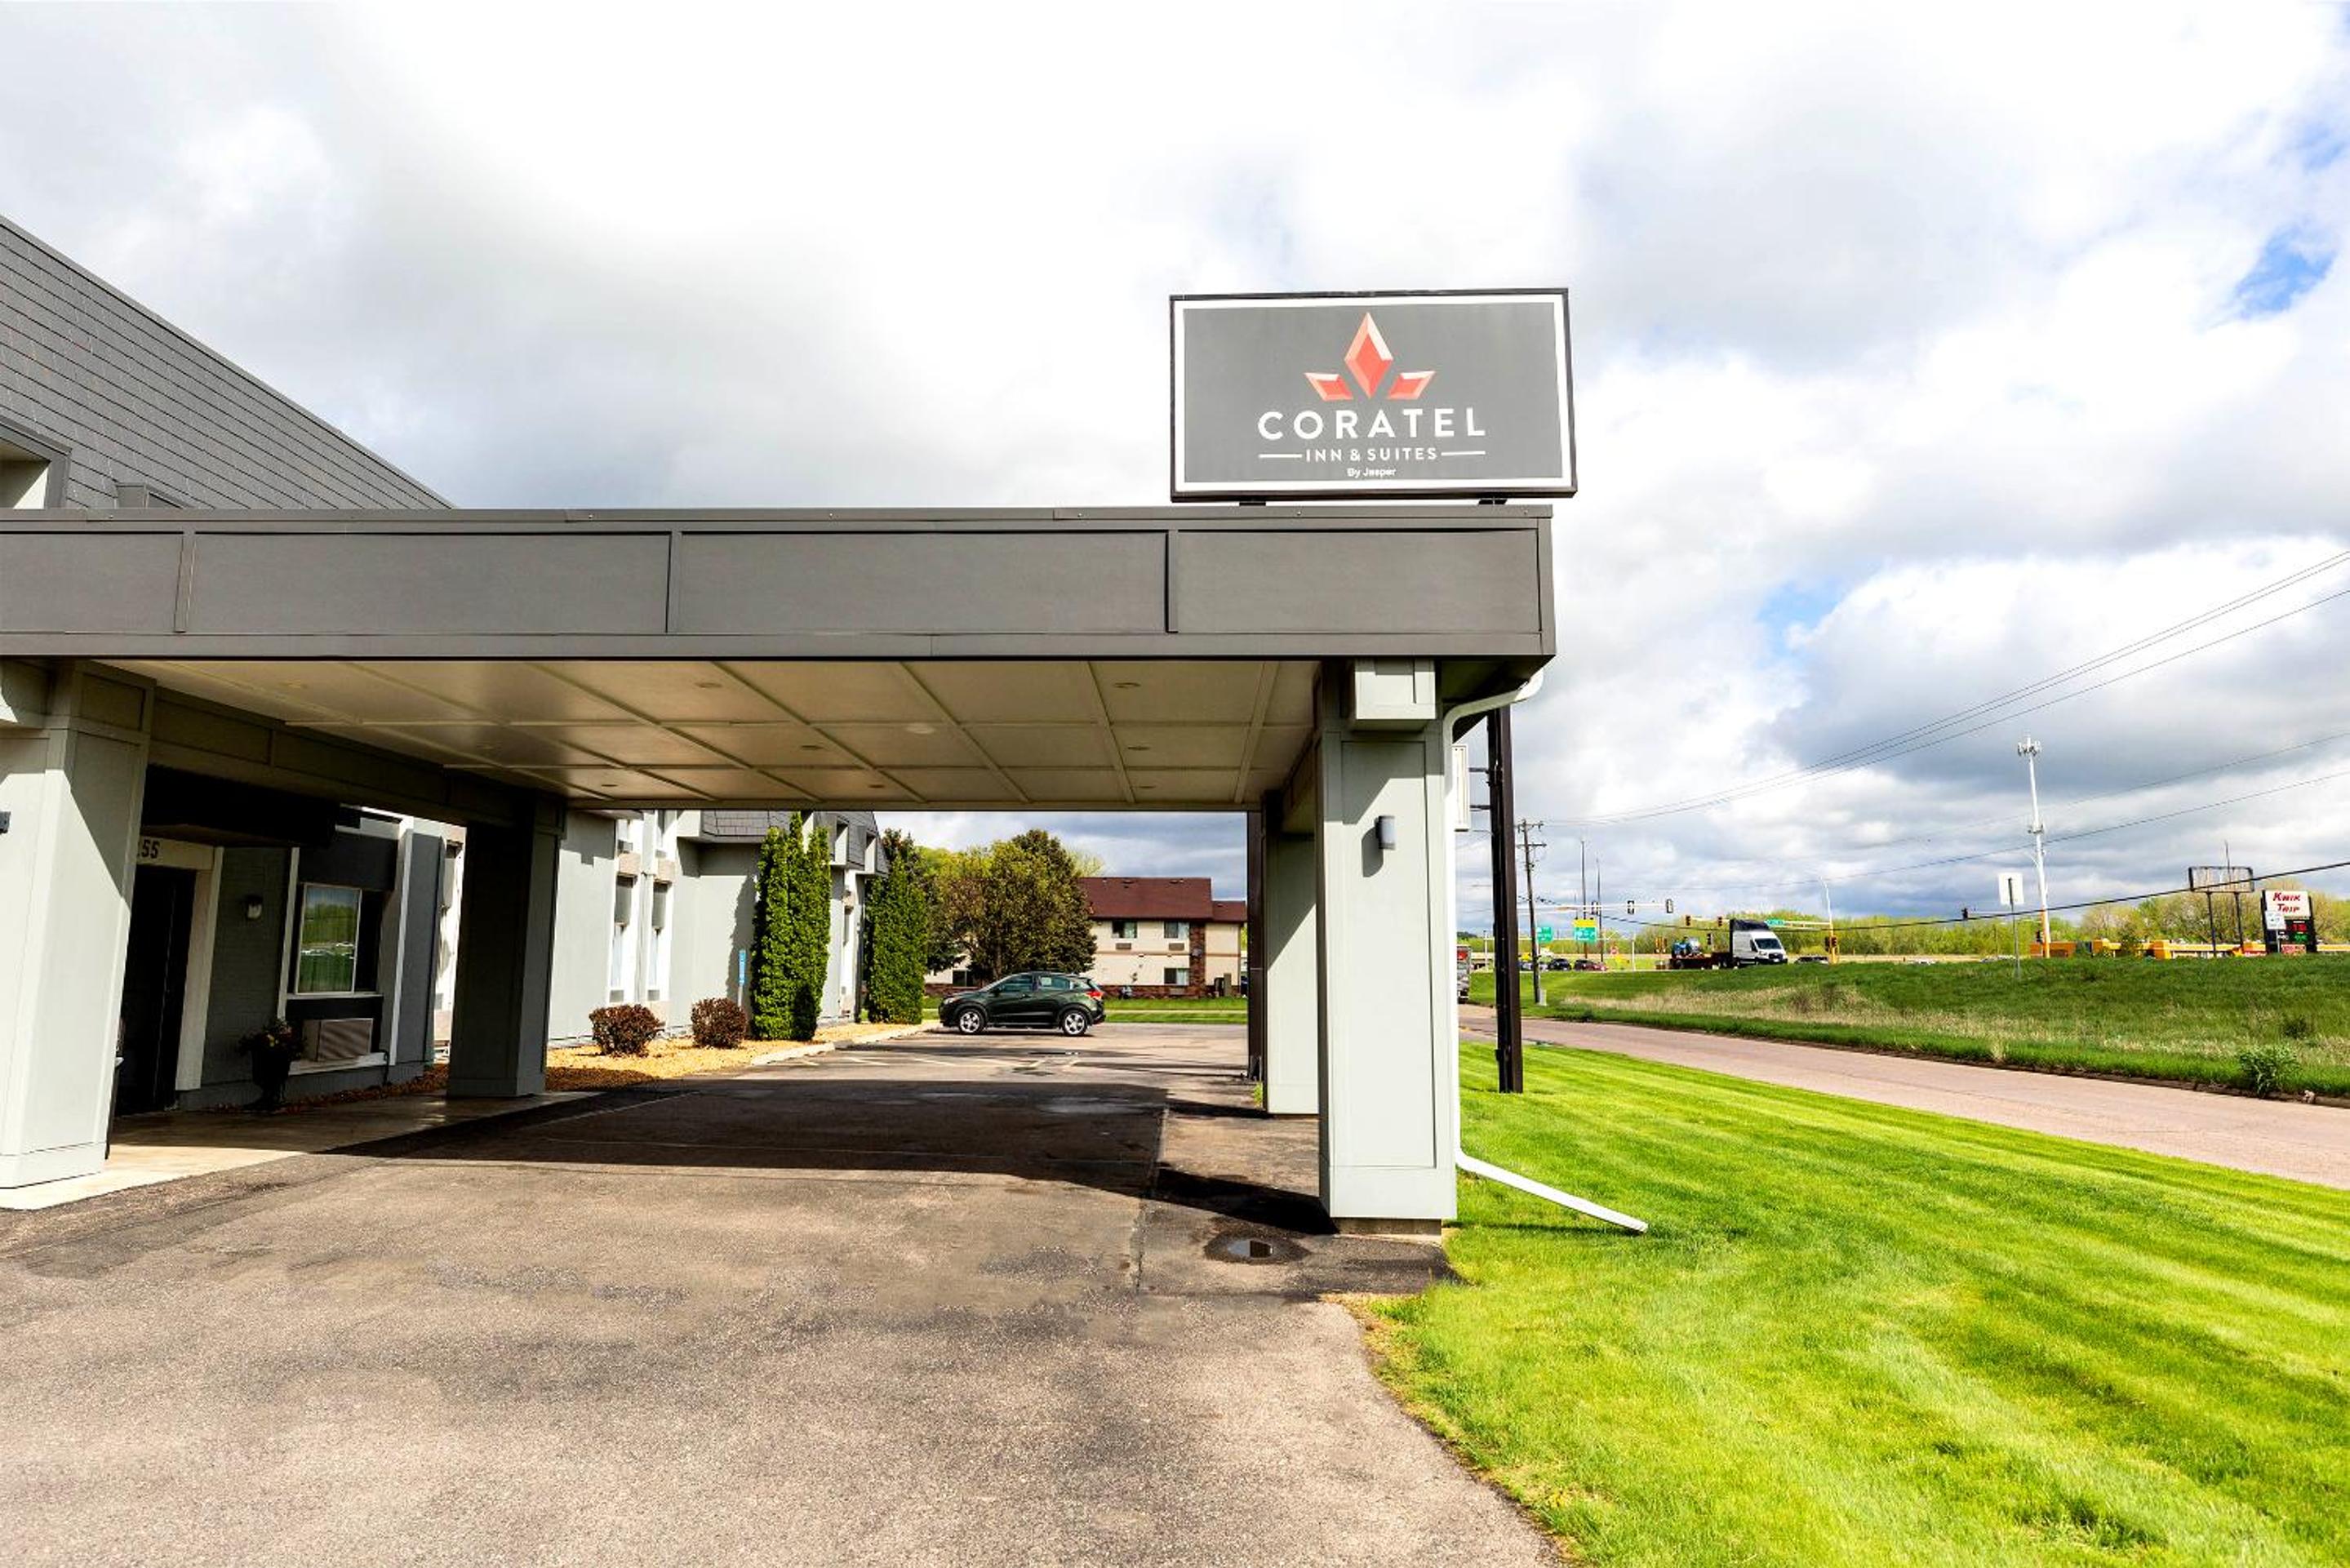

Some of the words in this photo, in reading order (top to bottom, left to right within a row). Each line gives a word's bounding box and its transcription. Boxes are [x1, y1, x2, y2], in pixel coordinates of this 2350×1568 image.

[1258, 407, 1486, 440] CORATEL
[1306, 448, 1342, 462] INN
[1350, 448, 1360, 461] &
[1367, 447, 1437, 461] SUITES
[1347, 468, 1361, 478] By
[1362, 467, 1397, 478] Jasper
[137, 839, 160, 859] 55
